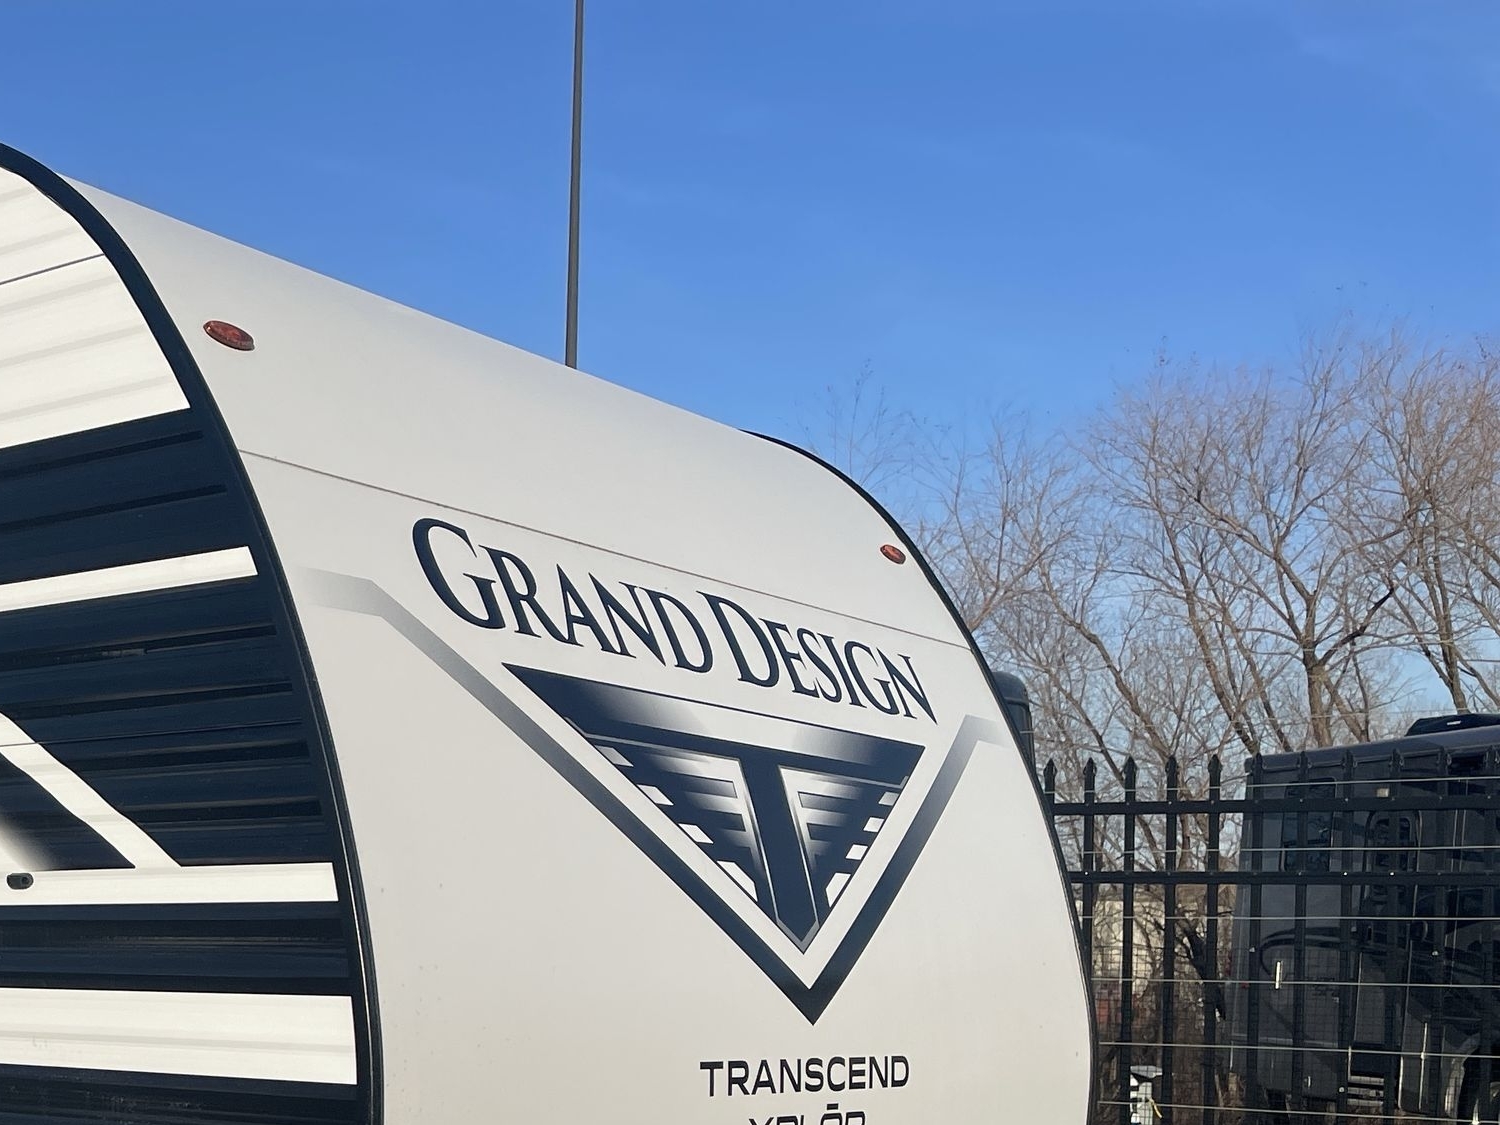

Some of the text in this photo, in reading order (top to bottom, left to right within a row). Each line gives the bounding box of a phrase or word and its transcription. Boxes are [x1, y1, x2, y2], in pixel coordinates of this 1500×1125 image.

[411, 517, 938, 725] GRAND DESIGN
[700, 1055, 910, 1097] TRANSCEND
